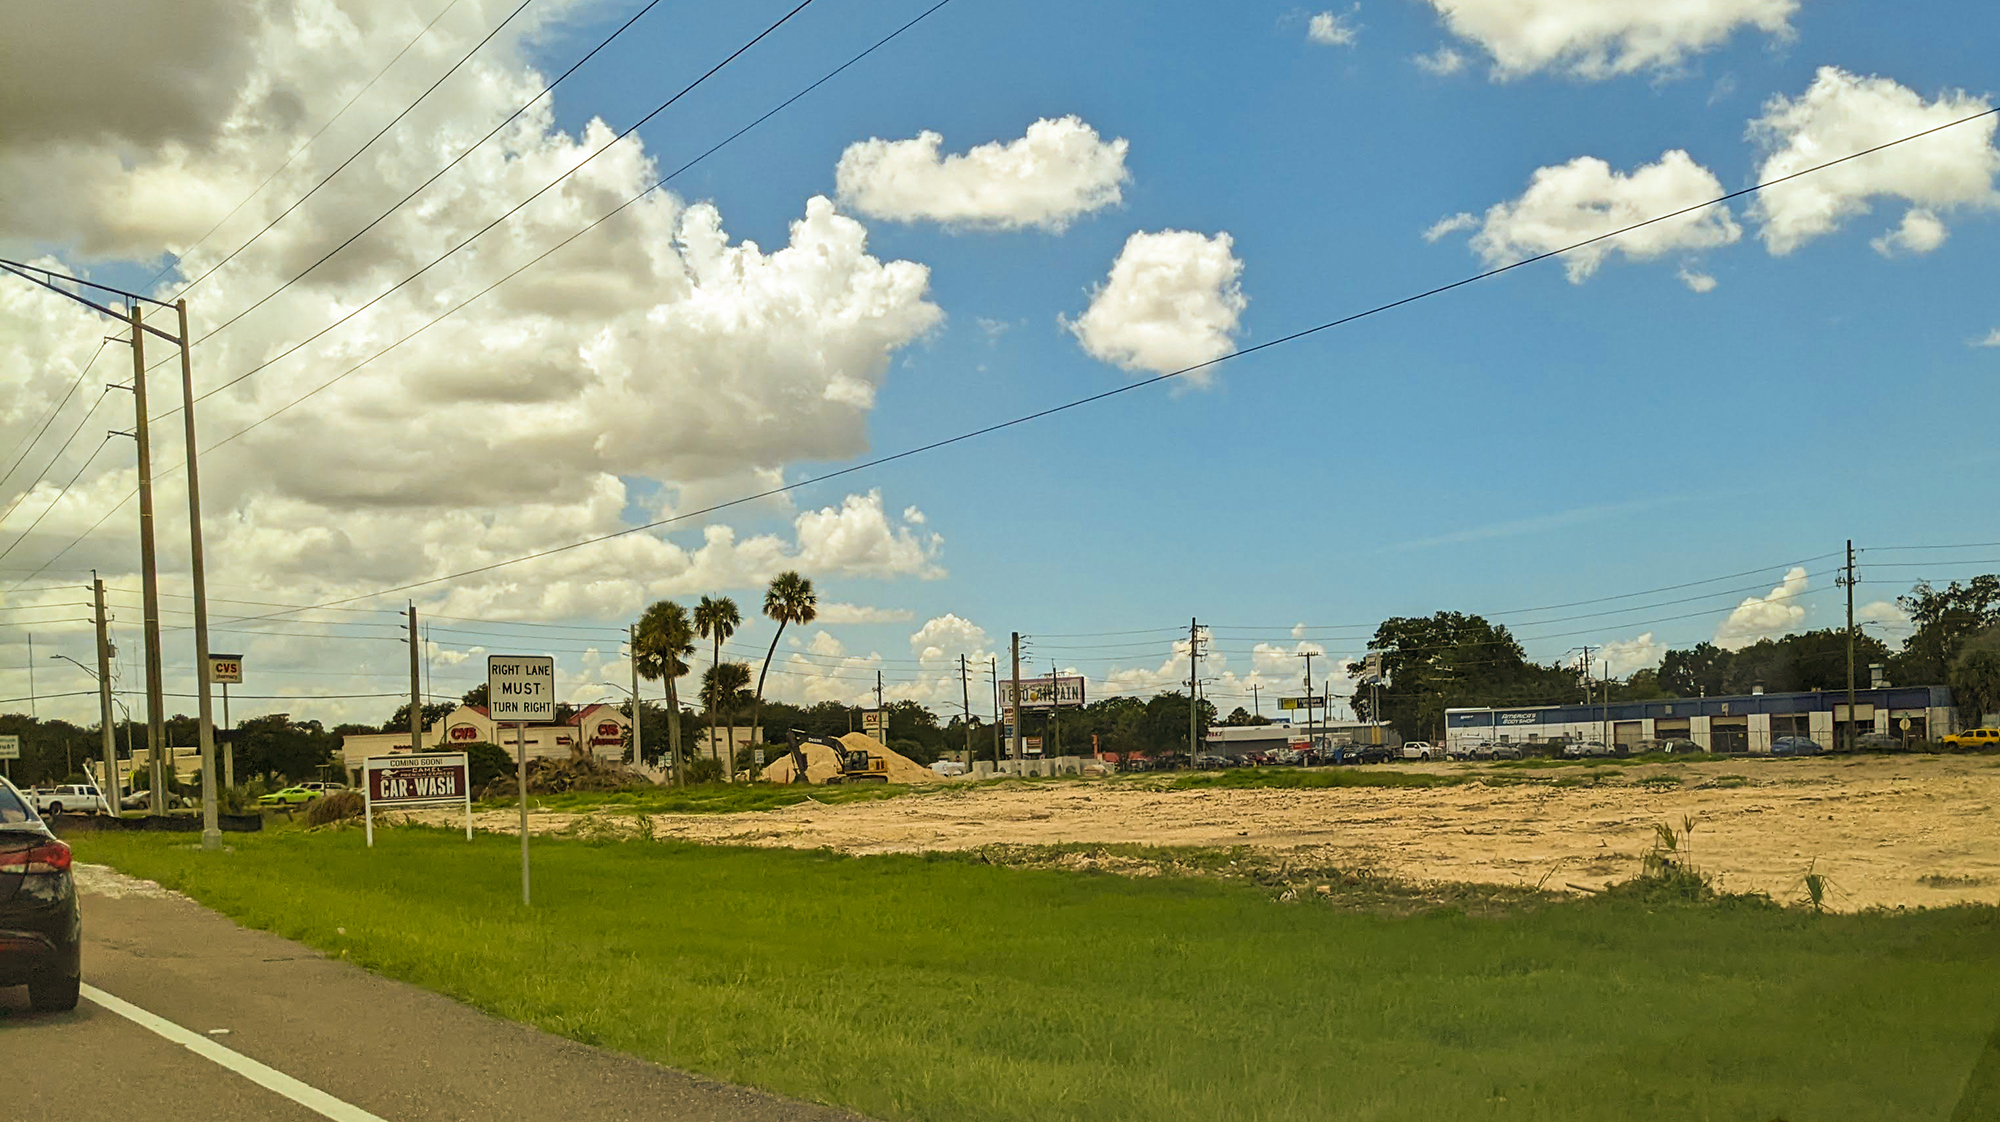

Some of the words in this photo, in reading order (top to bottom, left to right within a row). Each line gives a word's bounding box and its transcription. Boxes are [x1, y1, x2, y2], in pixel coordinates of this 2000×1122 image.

[216, 663, 237, 673] CVS
[492, 664, 519, 675] RIGHT
[526, 665, 550, 676] LANE
[502, 682, 541, 695] MUST
[493, 702, 518, 712] TURN
[523, 702, 551, 712] RIGHT
[451, 727, 477, 740] CVS
[598, 724, 618, 736] CVS
[390, 759, 419, 767] COMING
[421, 758, 443, 766] SOON!
[380, 780, 408, 798] CAR
[415, 777, 455, 796] WASH
